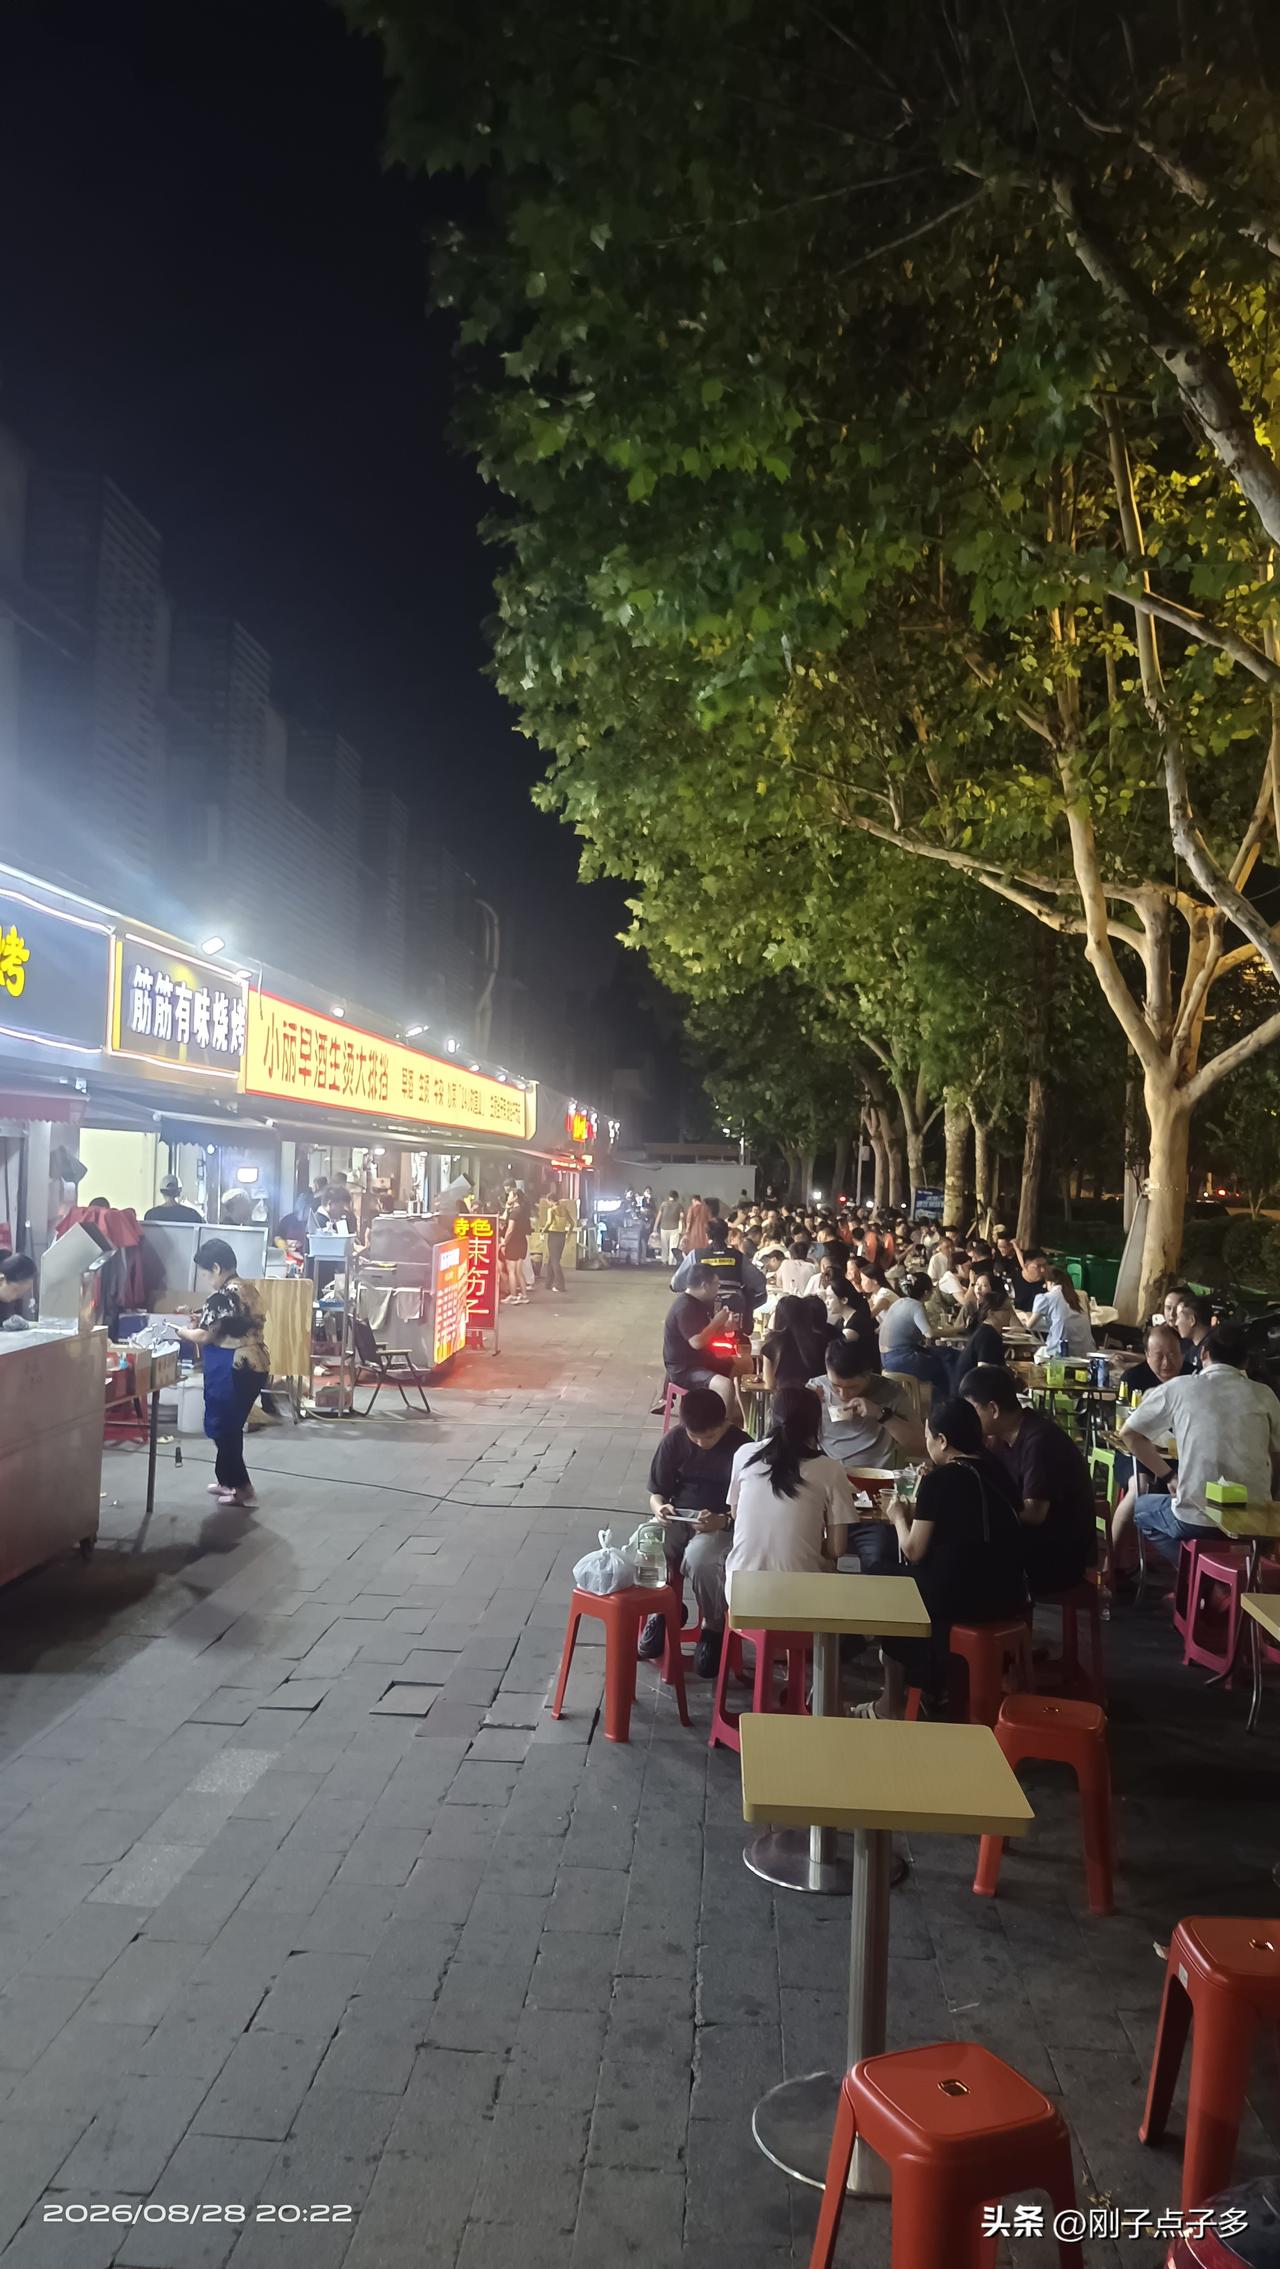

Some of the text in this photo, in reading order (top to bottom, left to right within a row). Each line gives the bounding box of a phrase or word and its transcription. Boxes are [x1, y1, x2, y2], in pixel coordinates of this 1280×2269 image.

[131, 963, 245, 1057] 筋筋有味烧烤
